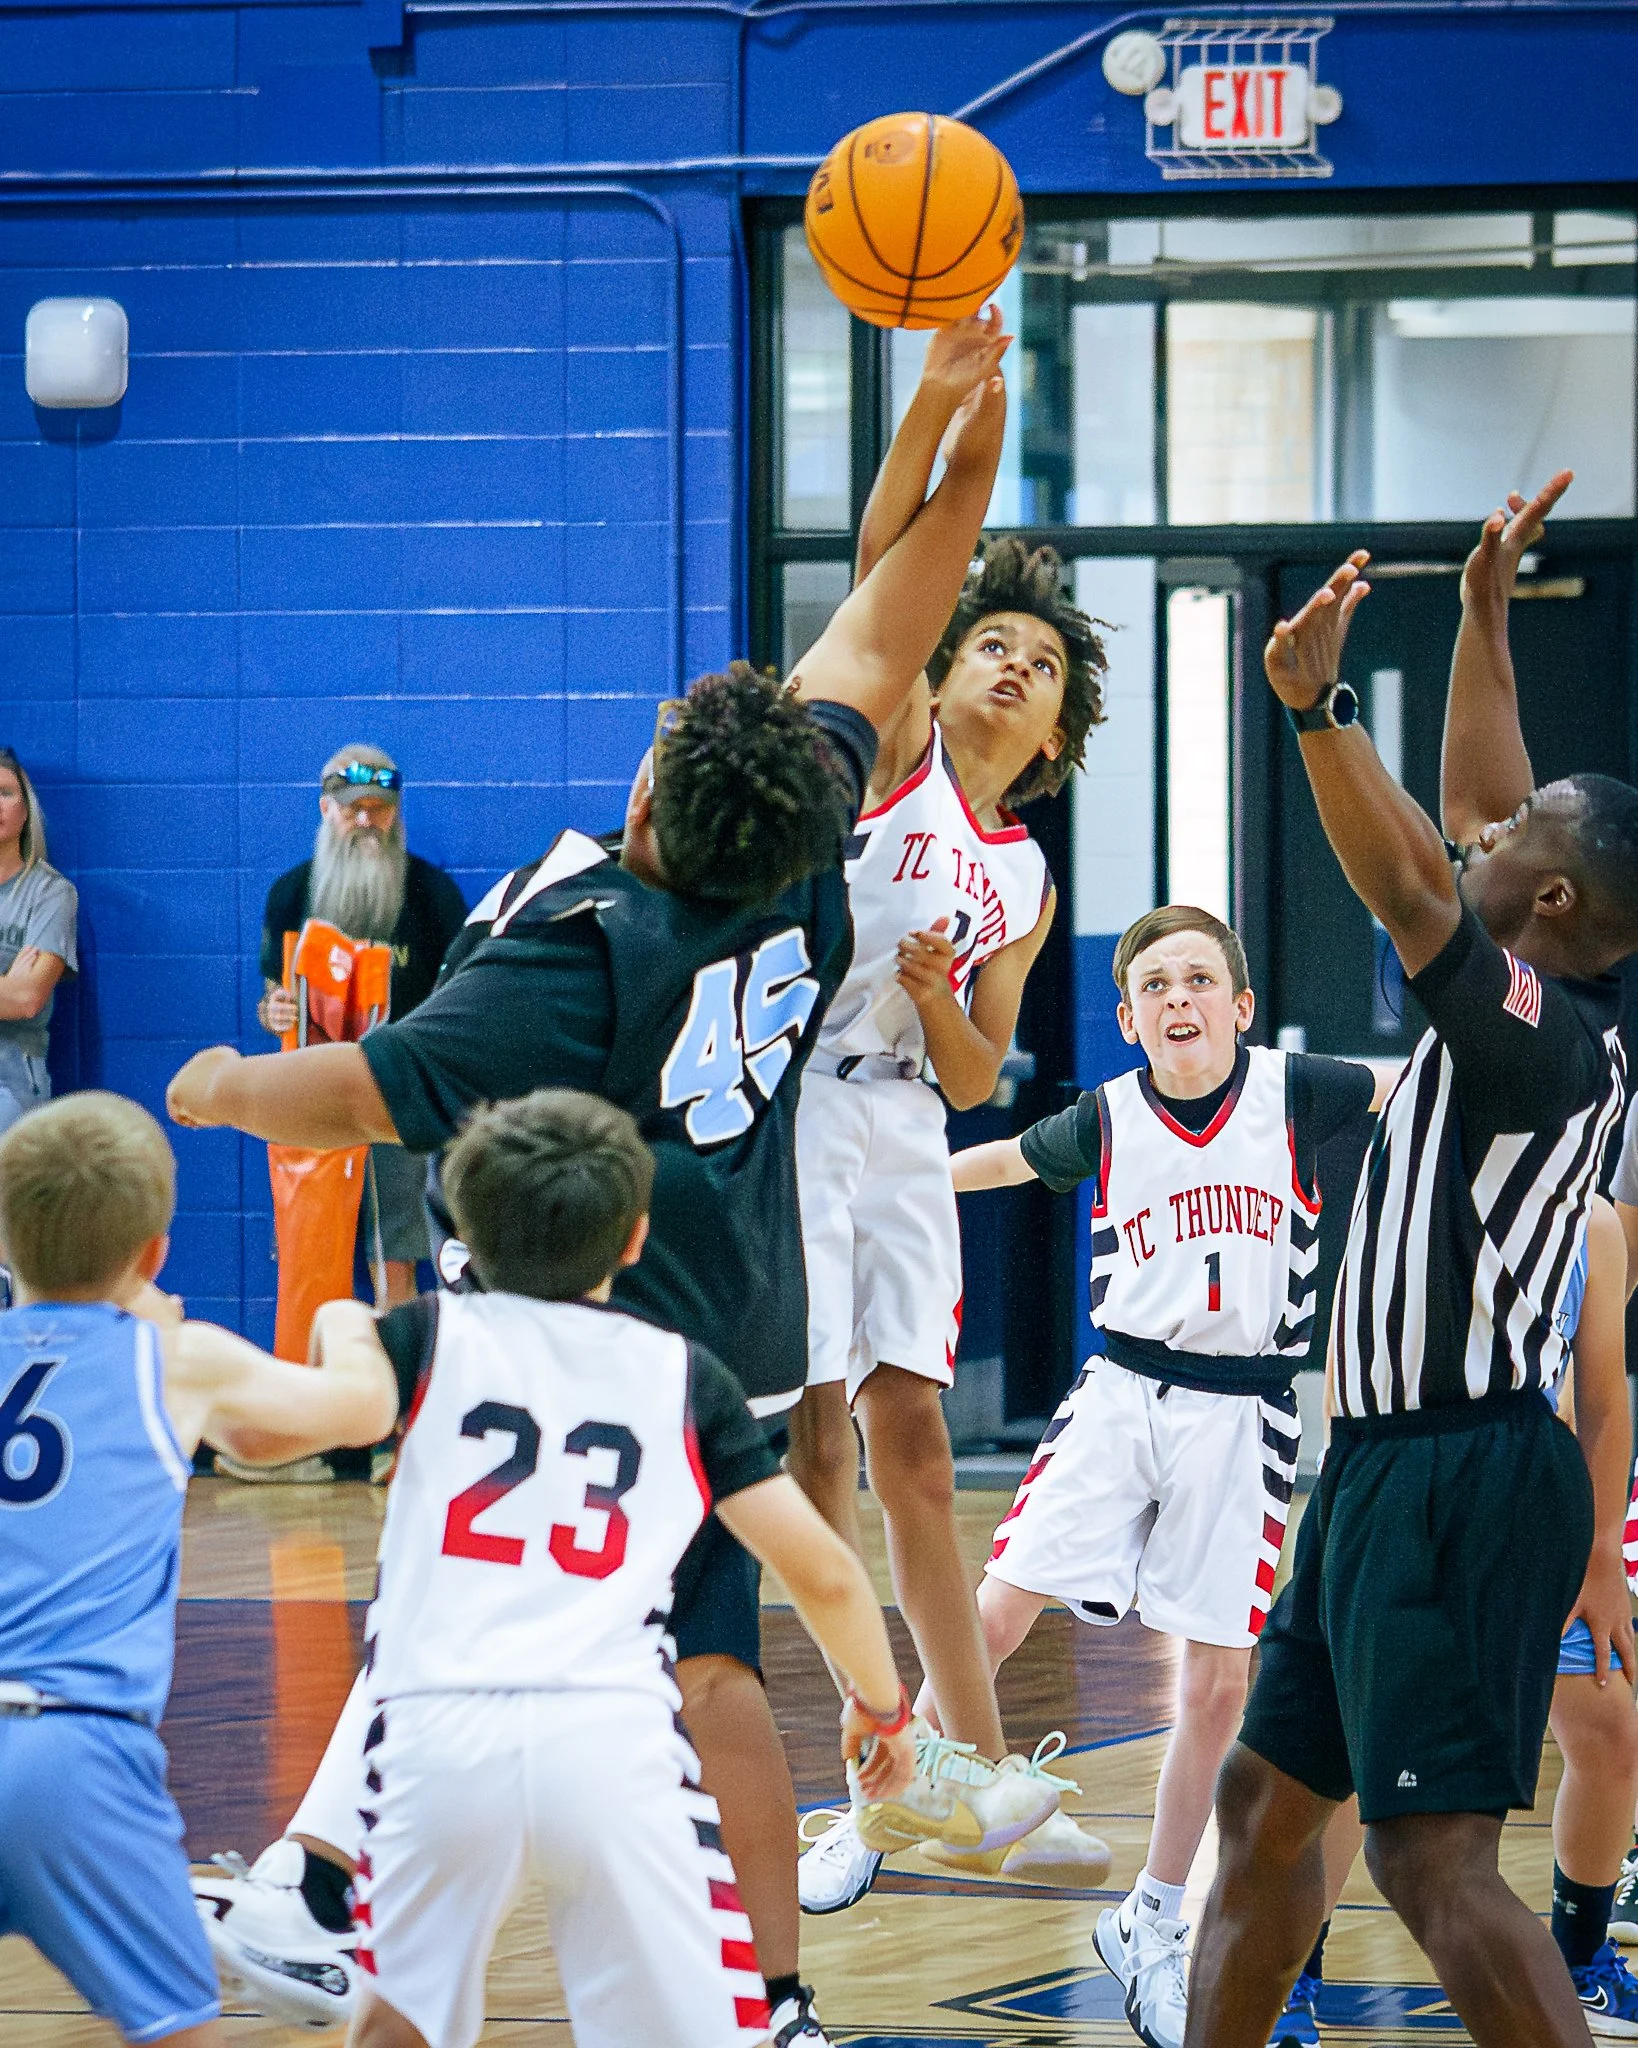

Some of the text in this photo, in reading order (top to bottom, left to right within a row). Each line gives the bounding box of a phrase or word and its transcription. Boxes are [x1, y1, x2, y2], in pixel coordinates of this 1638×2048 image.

[1203, 70, 1288, 139] EXIT
[892, 832, 938, 883] TC
[660, 926, 820, 1145] 45
[1123, 1184, 1284, 1268] TC THUNDER
[1204, 1251, 1221, 1312] 1
[0, 1355, 74, 1511] 6
[441, 1399, 643, 1581] 23
